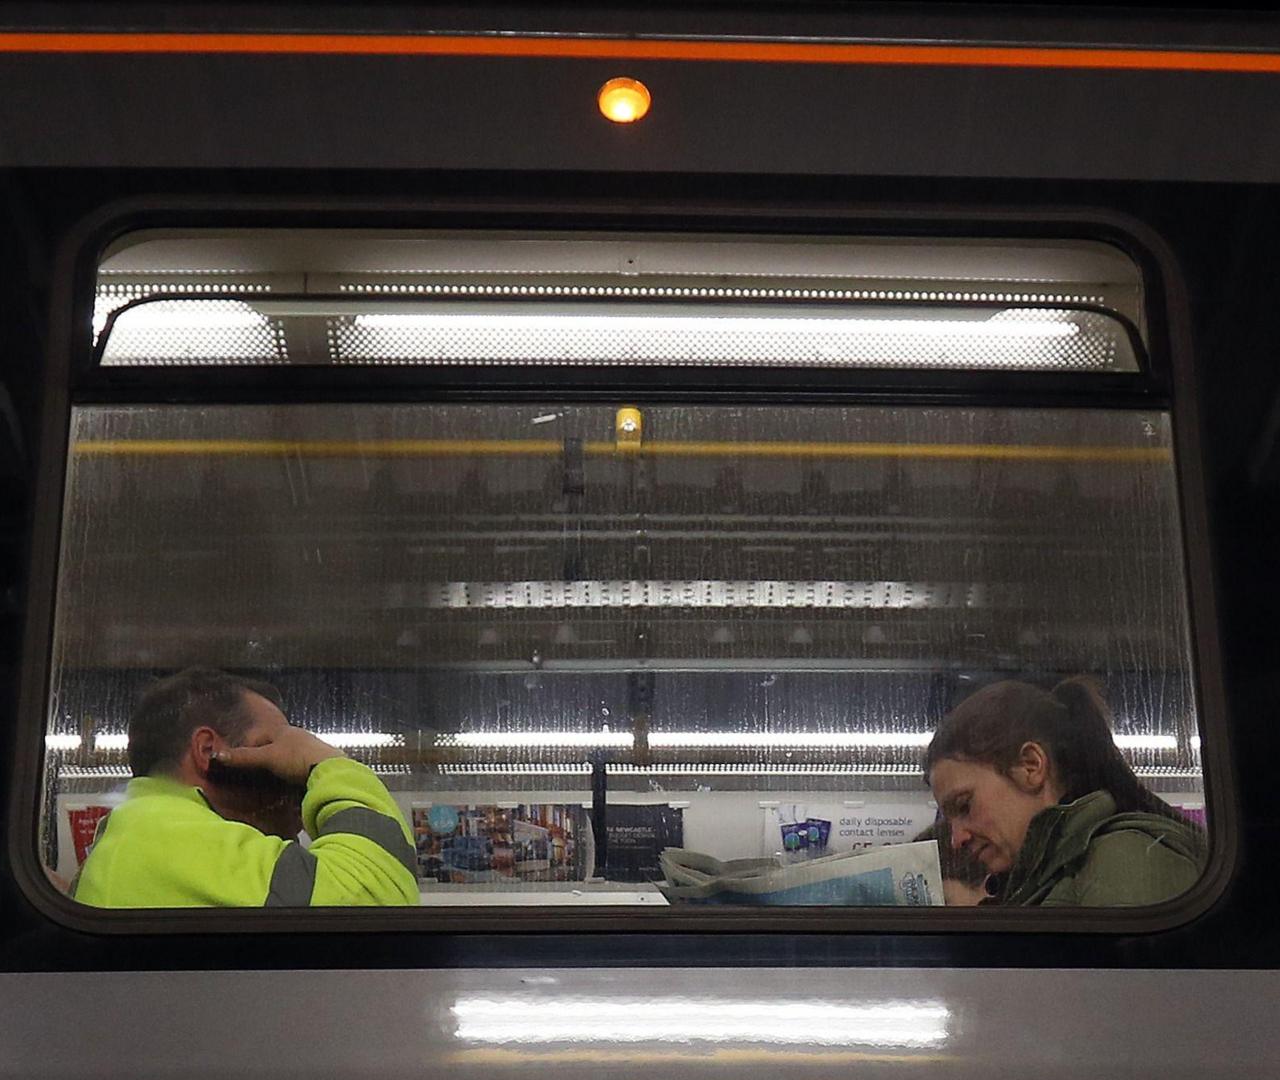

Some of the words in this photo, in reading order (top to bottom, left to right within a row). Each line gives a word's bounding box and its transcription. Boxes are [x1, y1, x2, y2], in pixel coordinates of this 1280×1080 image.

[840, 817, 861, 827] daily
[865, 817, 912, 827] disposable
[840, 829, 874, 837] contact
[877, 828, 904, 837] lenses
